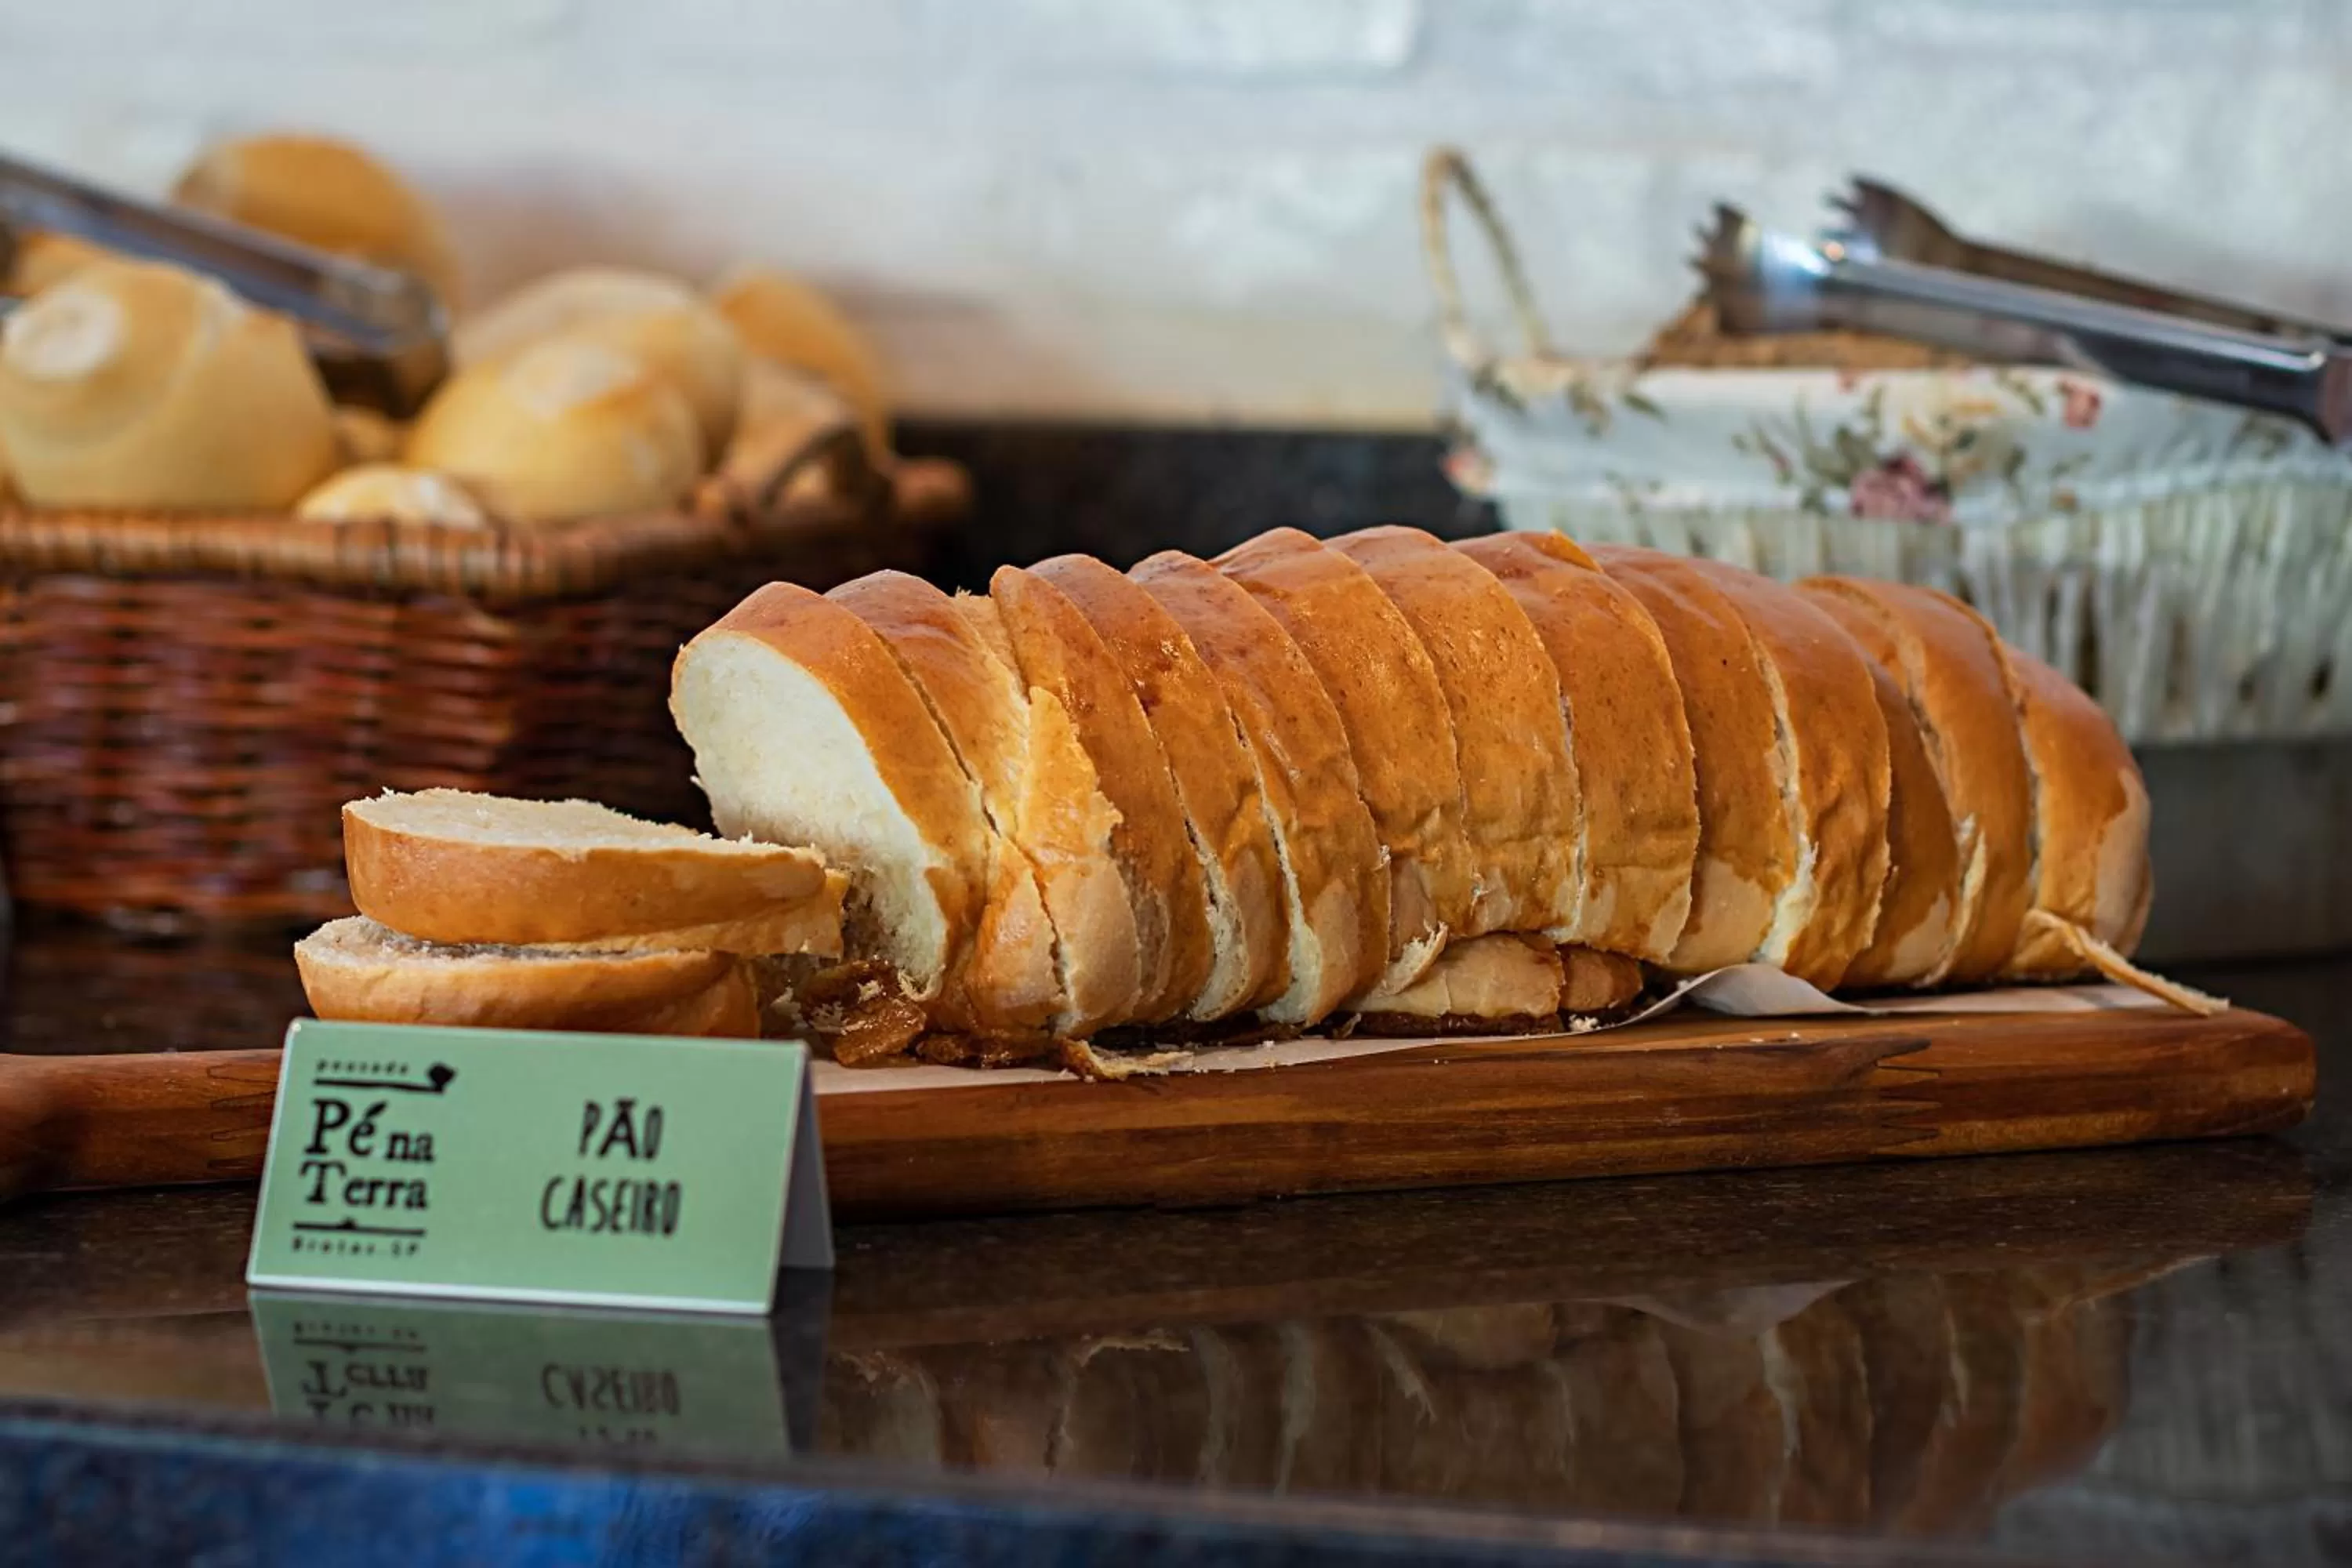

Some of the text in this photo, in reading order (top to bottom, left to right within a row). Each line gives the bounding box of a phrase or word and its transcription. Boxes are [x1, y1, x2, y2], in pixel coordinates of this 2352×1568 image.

[303, 1098, 436, 1163] Pé na
[577, 1097, 664, 1162] PÃO
[298, 1160, 428, 1210] Terra
[539, 1174, 681, 1239] CASEIRO
